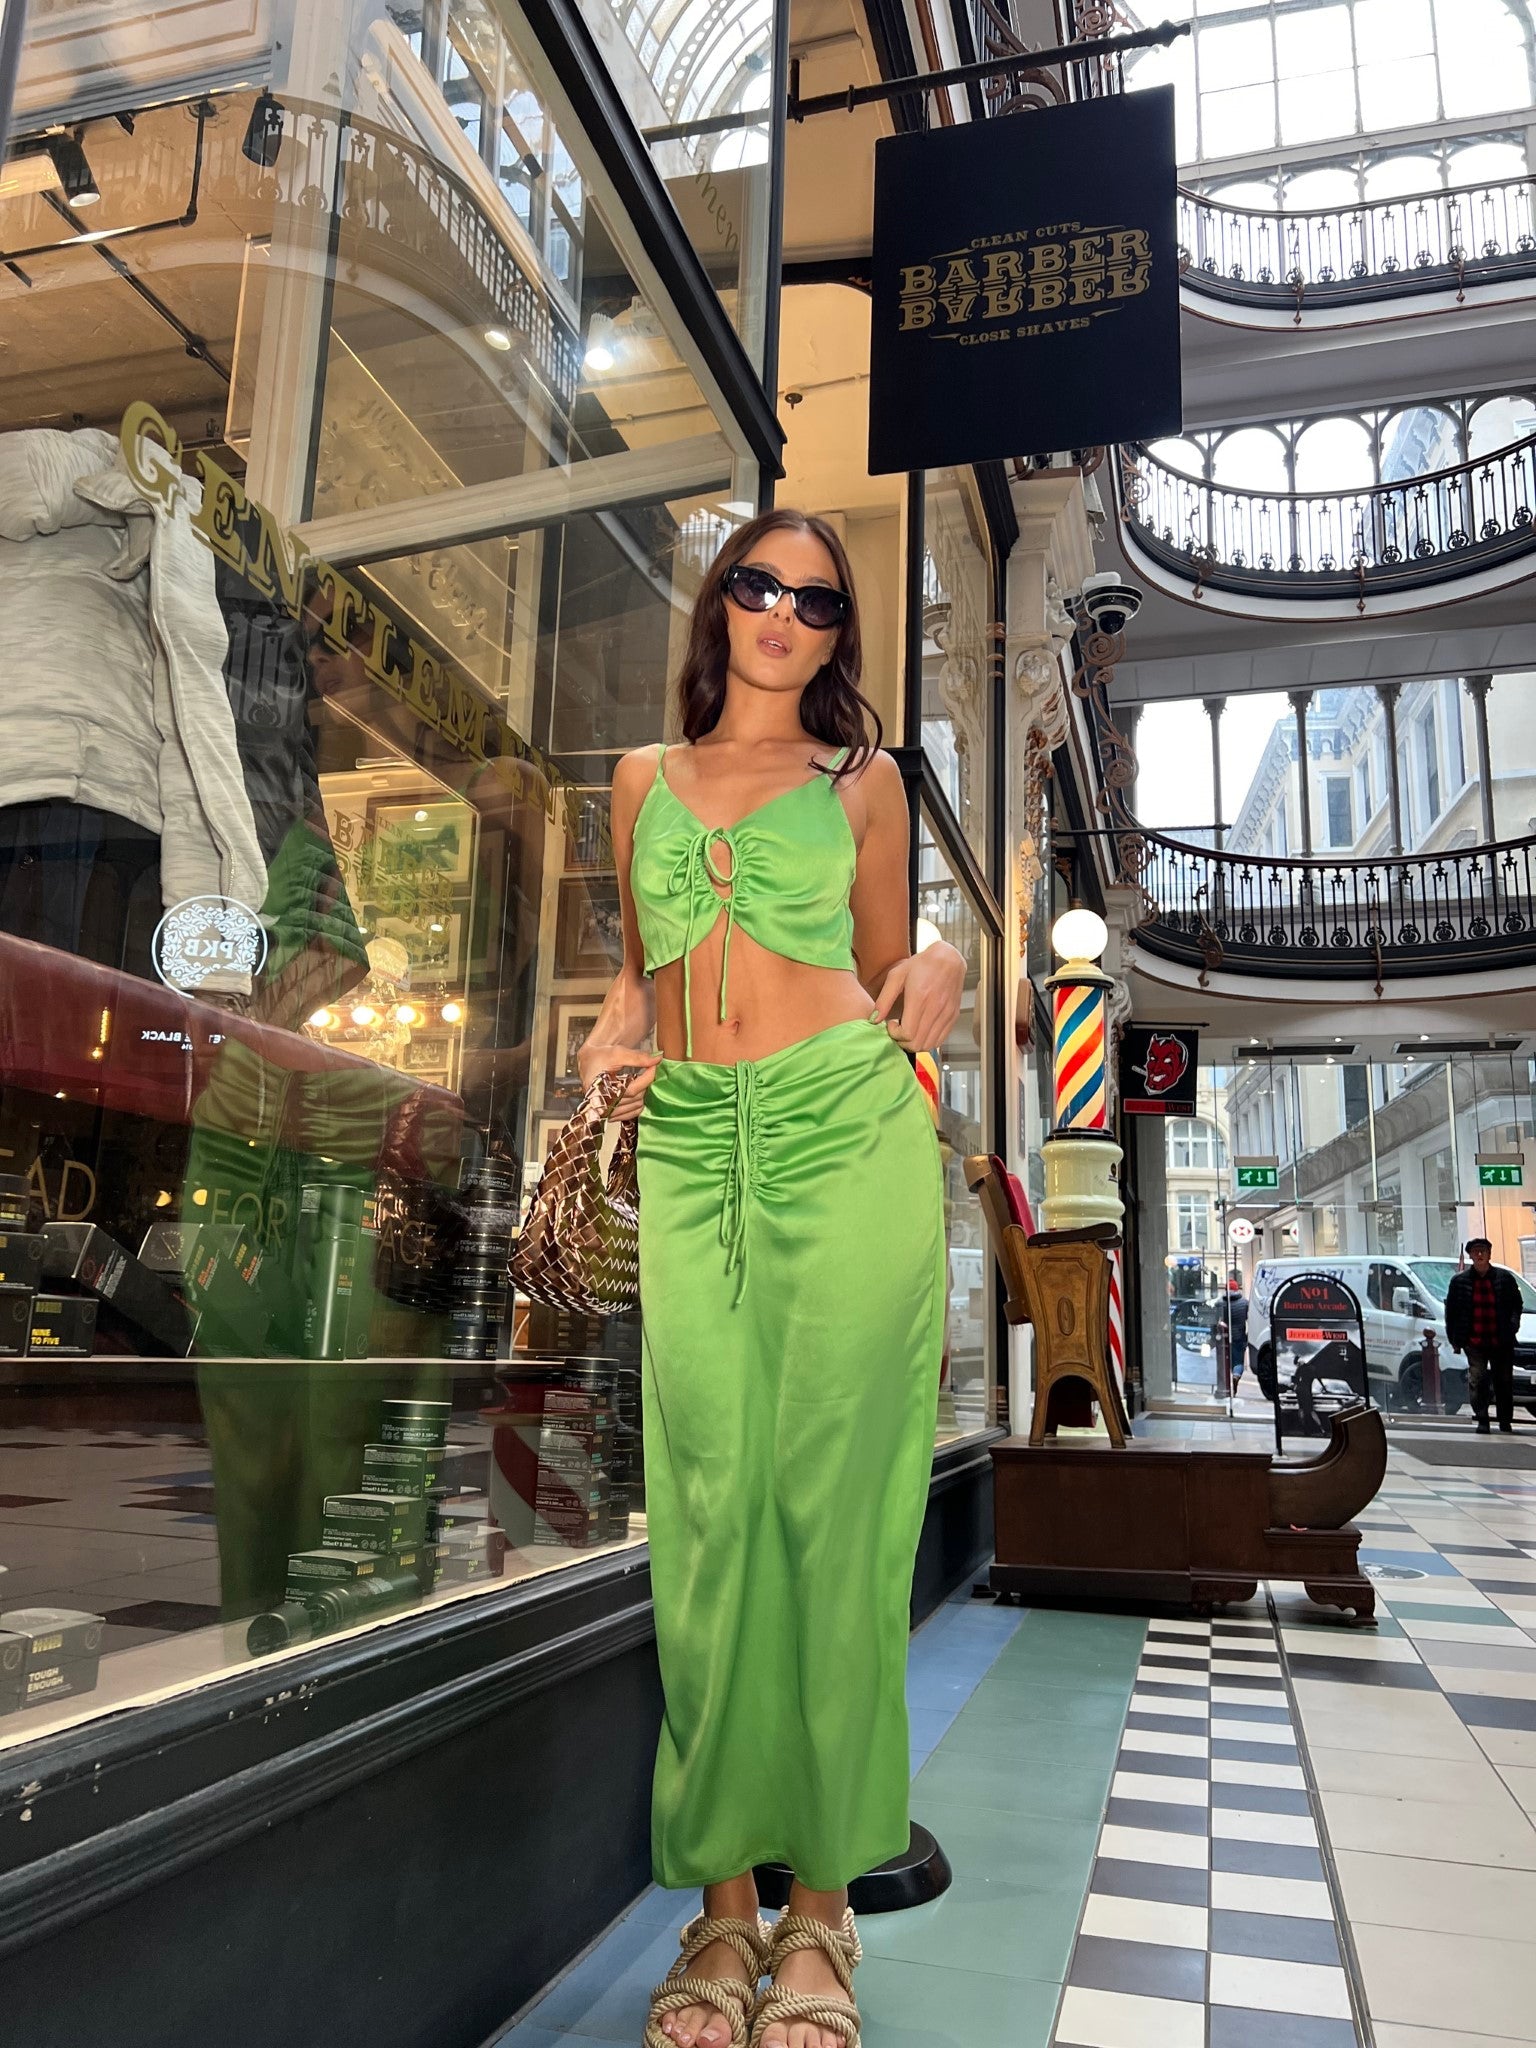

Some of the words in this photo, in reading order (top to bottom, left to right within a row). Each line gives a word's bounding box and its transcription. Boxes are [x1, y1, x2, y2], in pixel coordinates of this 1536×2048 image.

[970, 230, 1028, 249] CLEAN
[1036, 222, 1081, 239] CUTS
[899, 228, 1153, 299] BARBER
[959, 329, 1010, 345] CLOSE
[1016, 316, 1090, 338] SHAVES
[0, 1149, 96, 1221] AD
[211, 1188, 289, 1249] FOR
[377, 1220, 438, 1266] ACE
[1283, 1301, 1314, 1310] Barton
[1316, 1302, 1348, 1310] Arcade
[31, 1336, 42, 1345] TO
[43, 1337, 60, 1346] FIVE
[27, 1675, 64, 1693] ENOUGH
[28, 1667, 60, 1682] TOUGH
